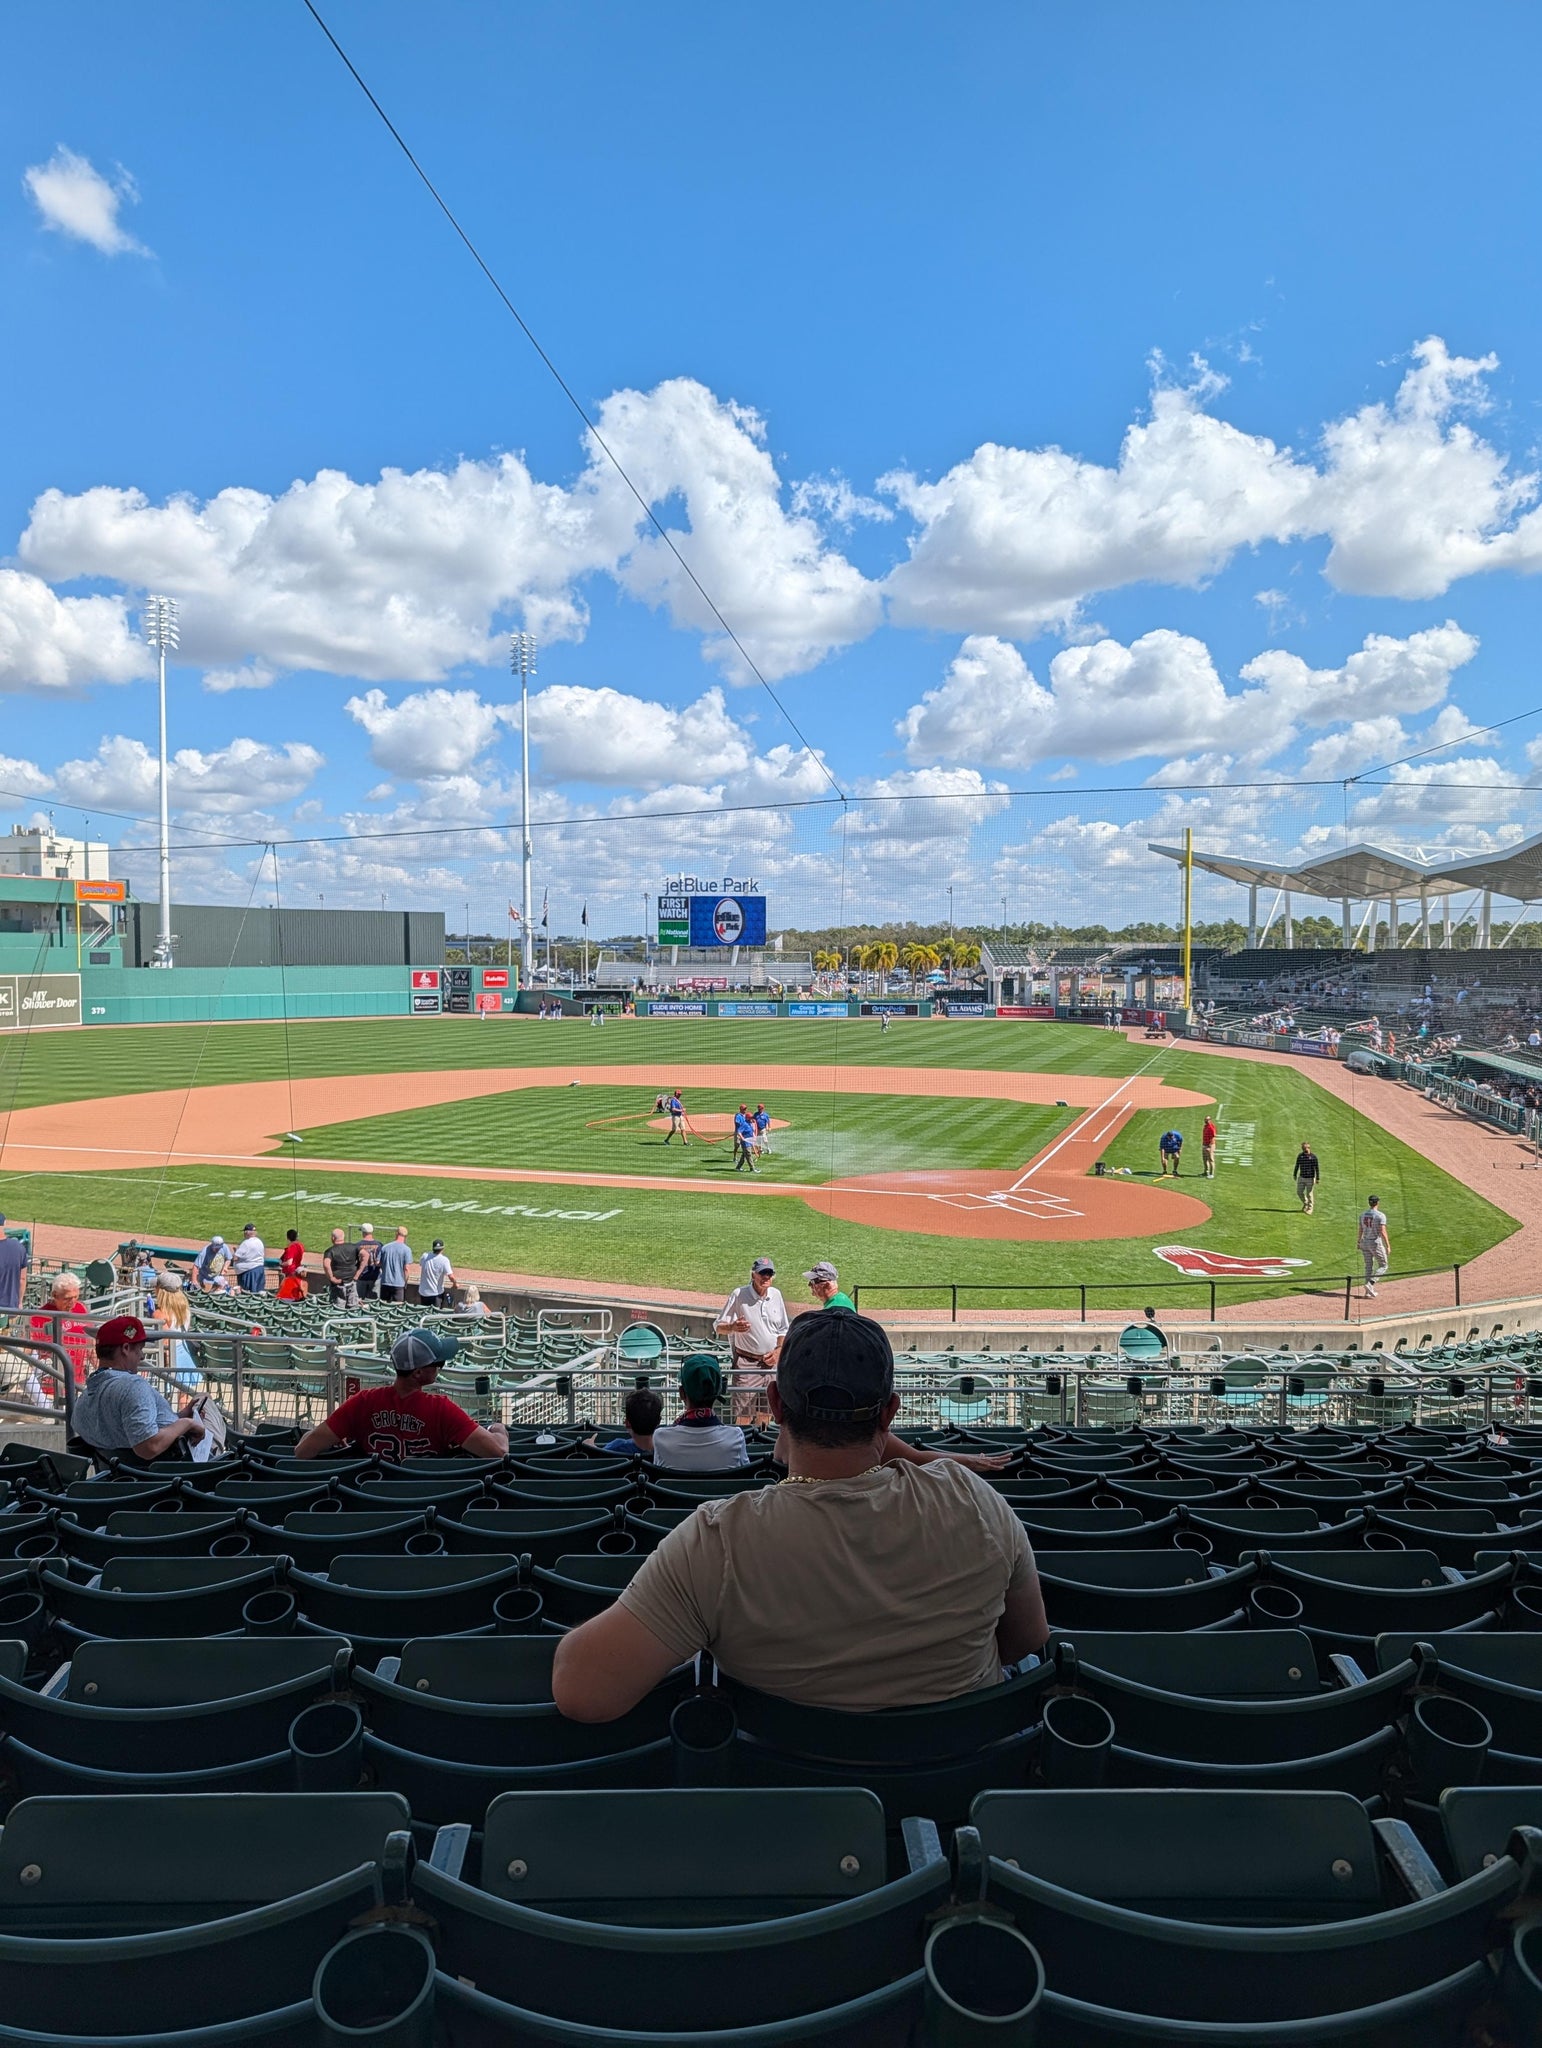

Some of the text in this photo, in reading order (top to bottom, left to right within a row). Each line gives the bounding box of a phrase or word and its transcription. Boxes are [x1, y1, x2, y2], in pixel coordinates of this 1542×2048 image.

[665, 877, 760, 896] jetBlue Park
[661, 898, 686, 908] FIRST
[659, 908, 688, 919] WATCH
[32, 990, 48, 1001] MY
[21, 997, 78, 1010] Shower Door
[959, 1005, 983, 1014] ADAMS
[269, 1190, 624, 1222] MassMutual
[348, 1383, 356, 1393] 2
